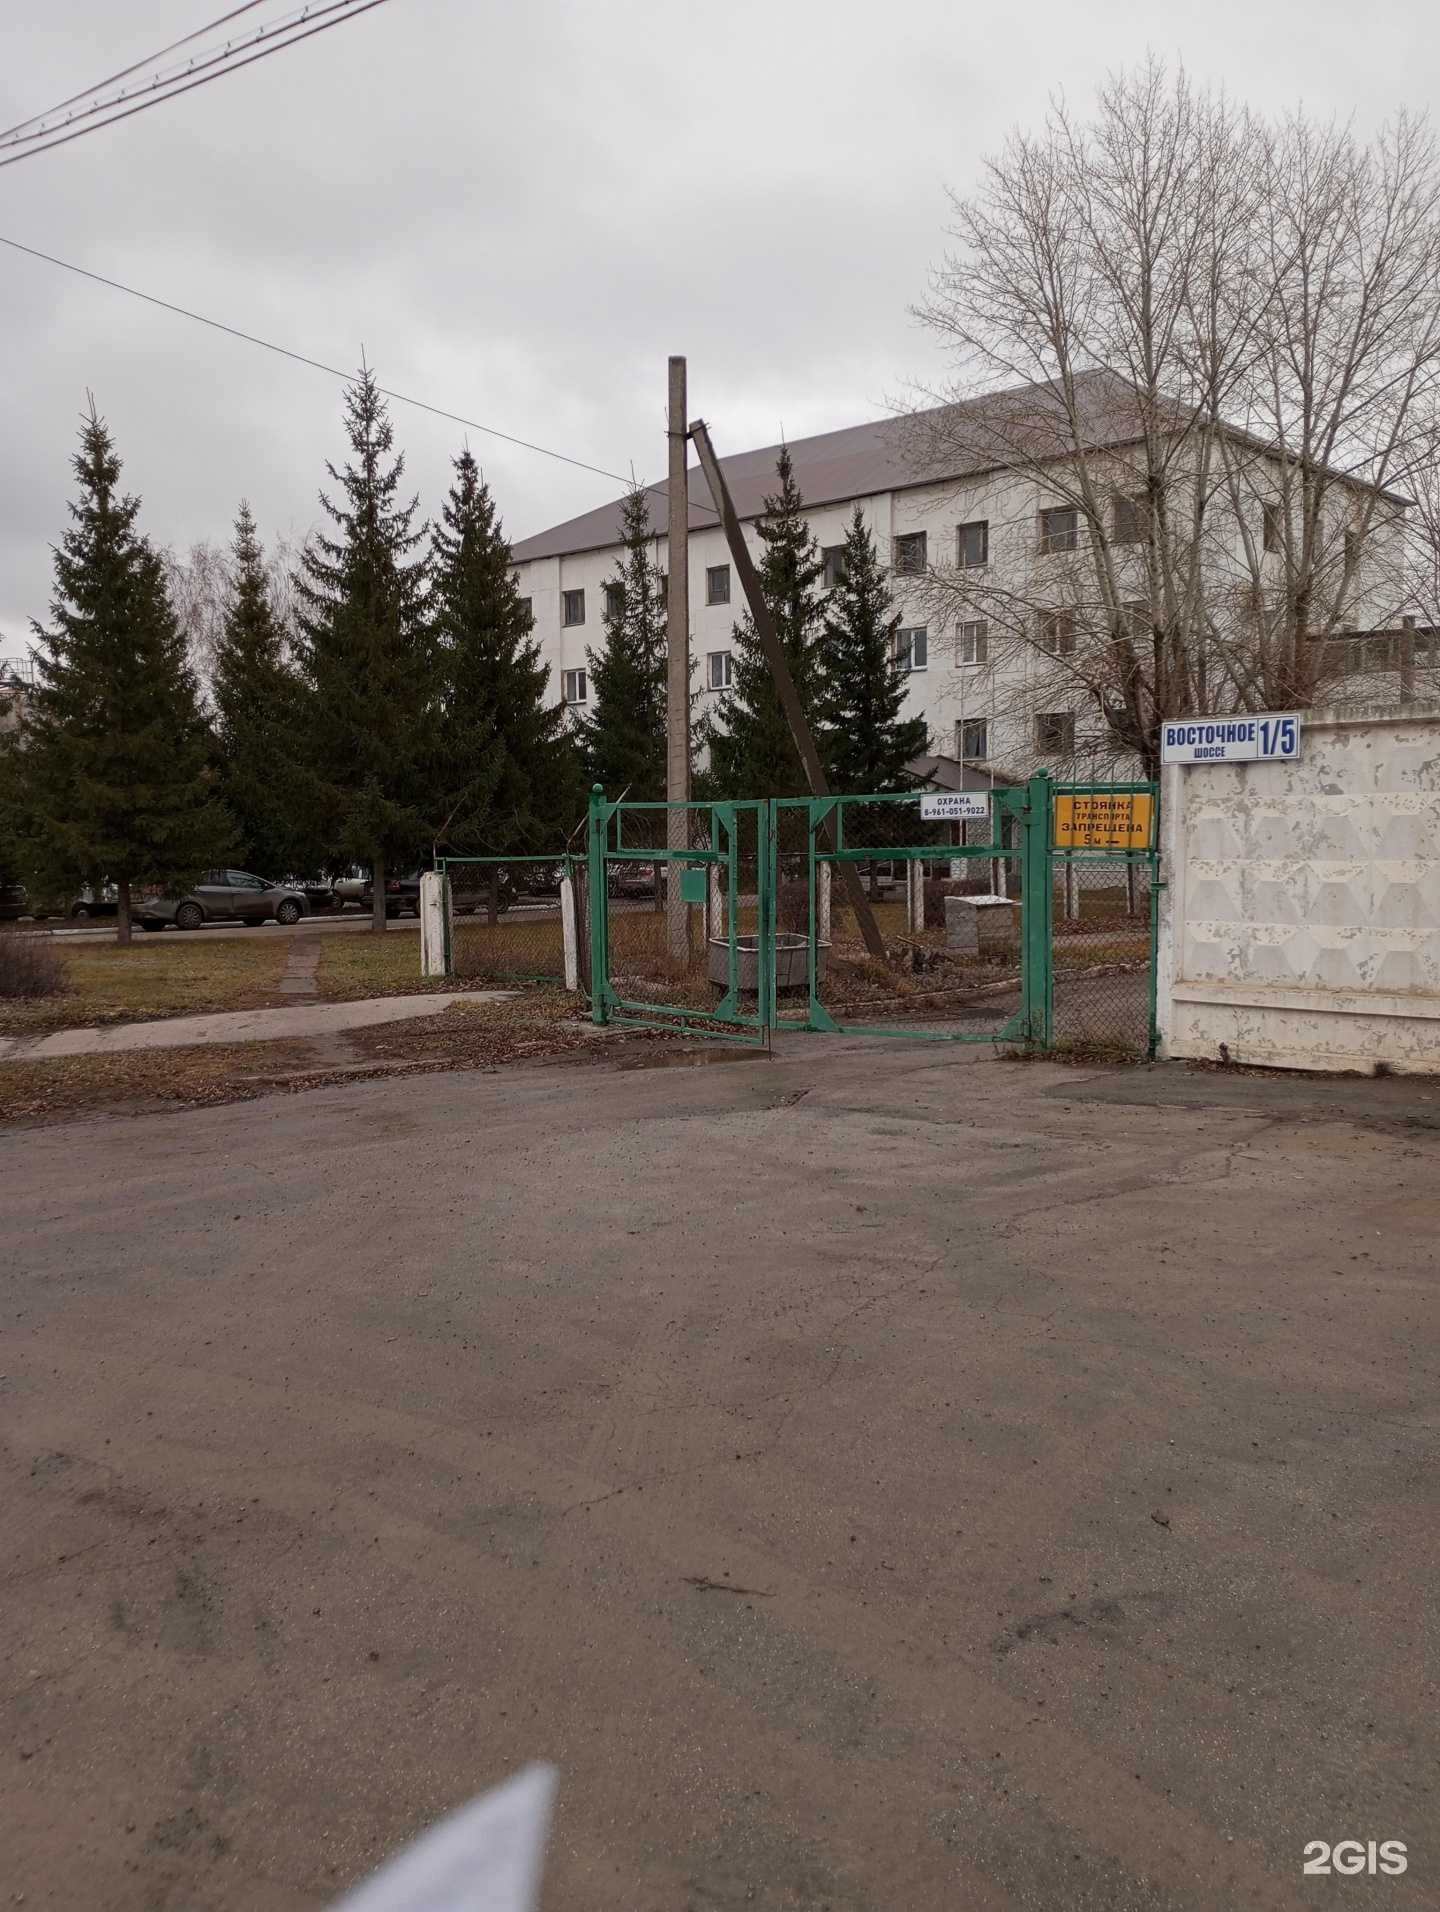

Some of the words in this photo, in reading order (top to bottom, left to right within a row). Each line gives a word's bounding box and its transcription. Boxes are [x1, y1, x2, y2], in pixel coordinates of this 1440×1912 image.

[1166, 723, 1255, 746] ВОСТОЧНОЕ
[1260, 719, 1295, 755] 1/5
[1194, 746, 1226, 758] ШОССЕ
[937, 797, 971, 805] ОХРАНА
[1073, 801, 1134, 810] СТОЯНКА
[1061, 823, 1143, 832] ЗАПРЕЩЕНА
